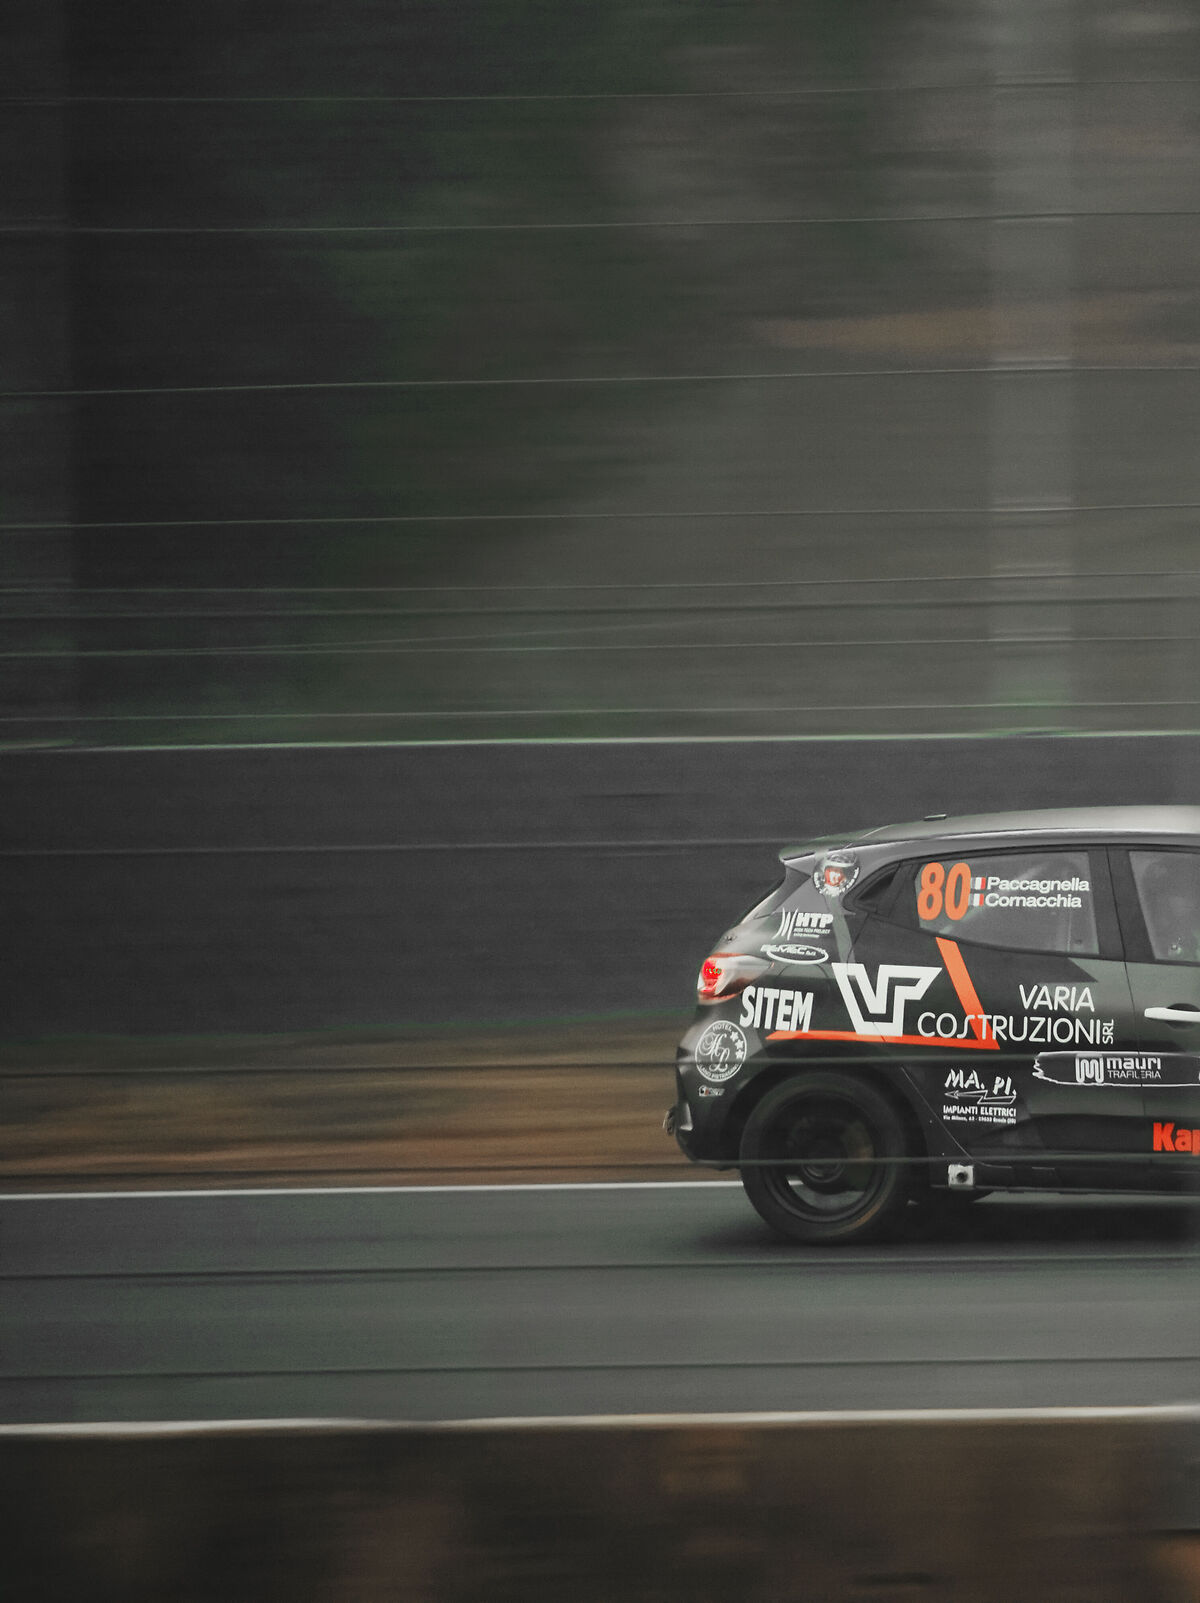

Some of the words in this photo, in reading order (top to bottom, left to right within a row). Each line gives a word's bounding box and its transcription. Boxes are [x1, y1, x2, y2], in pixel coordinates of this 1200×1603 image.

[917, 862, 972, 921] 80
[987, 876, 1090, 893] Paccagnella
[985, 893, 1082, 908] Cornacchia
[795, 912, 834, 929] HTP
[1019, 984, 1095, 1012] VARIA
[740, 985, 814, 1033] SITEM
[712, 1022, 732, 1032] HOTEL
[917, 1011, 1101, 1045] COSTRUZIONI
[1102, 1019, 1114, 1045] SRL
[1106, 1057, 1162, 1070] mauri
[1107, 1070, 1162, 1080] TRAFILERIA
[943, 1105, 978, 1115] IMPIANTI
[980, 1107, 1017, 1117] ELETTRICI
